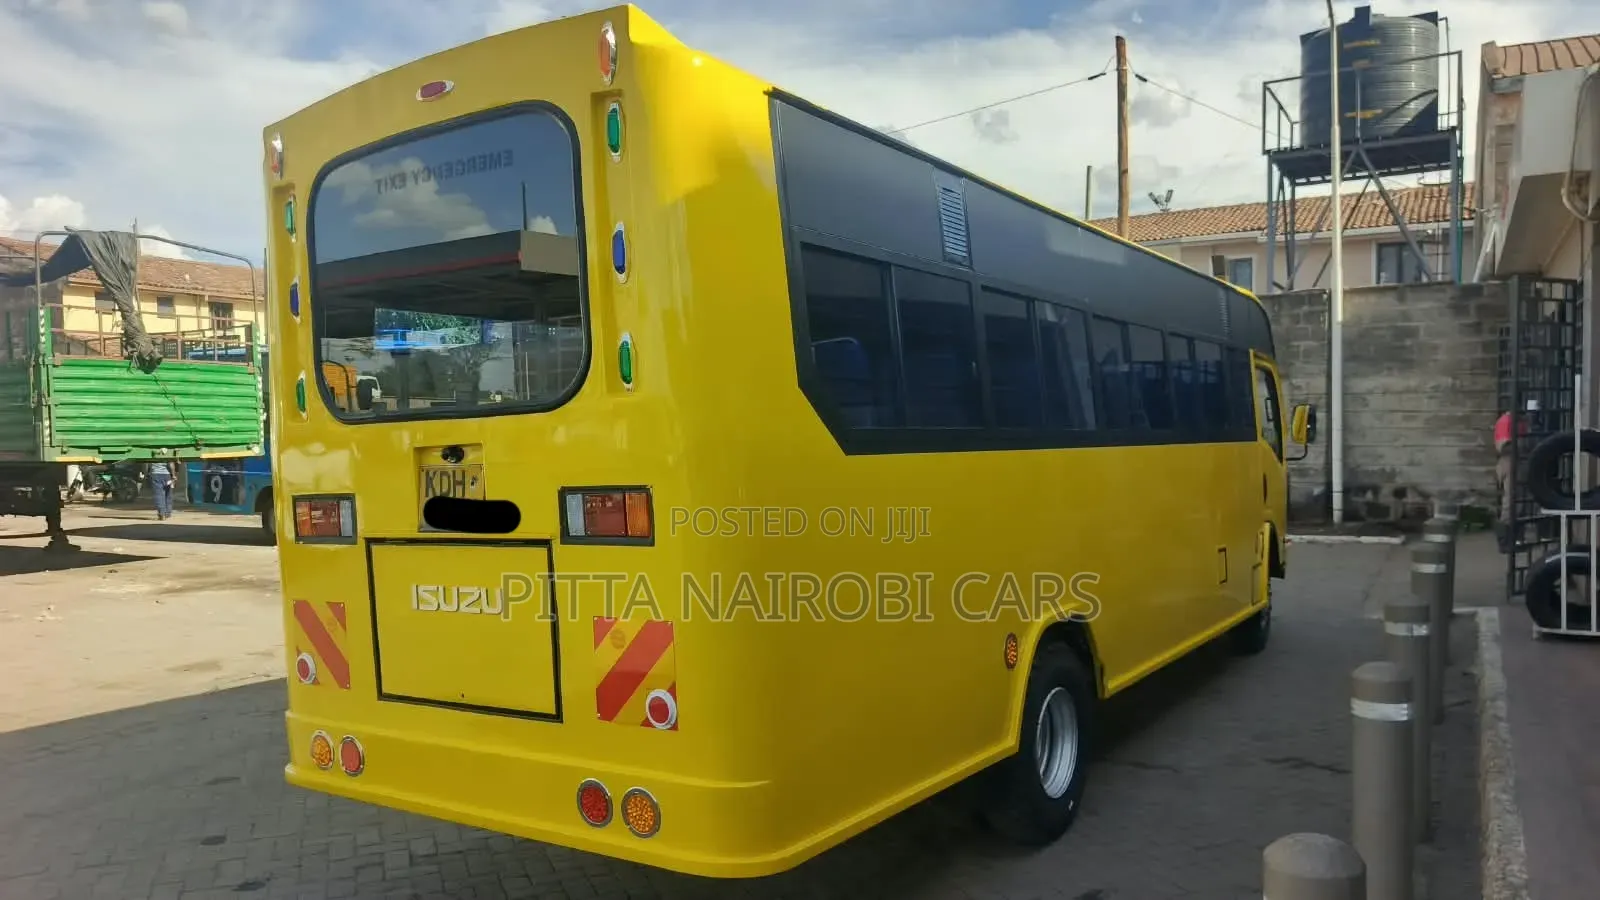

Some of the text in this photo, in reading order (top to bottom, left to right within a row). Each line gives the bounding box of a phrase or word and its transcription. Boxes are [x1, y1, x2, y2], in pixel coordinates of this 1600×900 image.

[210, 475, 223, 503] 9
[424, 469, 466, 498] KDH
[411, 583, 504, 615] ISUZU
